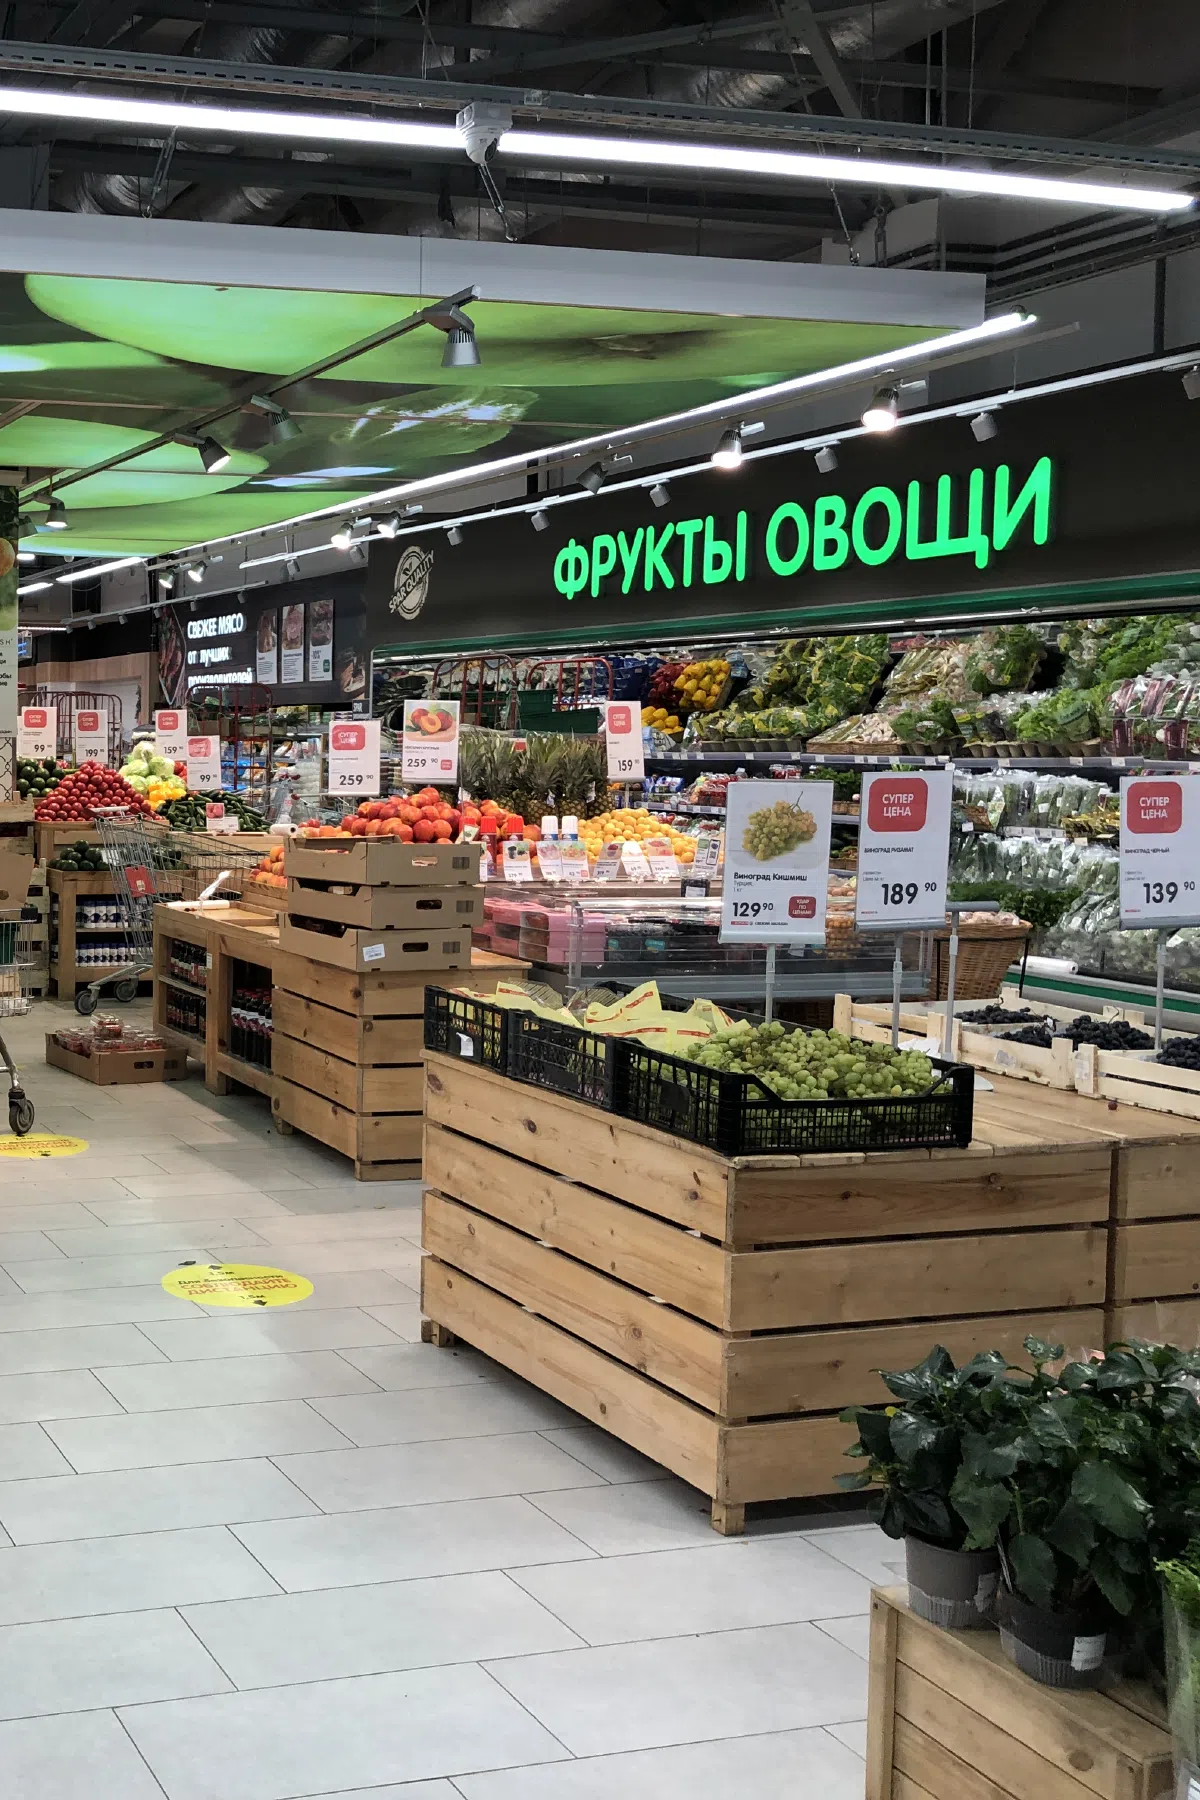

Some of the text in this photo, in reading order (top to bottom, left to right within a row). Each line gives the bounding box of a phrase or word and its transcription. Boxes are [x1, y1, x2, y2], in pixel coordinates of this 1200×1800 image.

[554, 456, 1052, 600] ФРУКТЫ ОВОЩИ
[388, 550, 434, 613] SPAR QUALITY
[187, 612, 245, 639] СВЕЖЕЕ МЯСО
[187, 646, 231, 667] от лучших
[339, 731, 358, 739] СУПЕР
[34, 744, 45, 752] 99
[85, 748, 99, 757] 199
[164, 746, 178, 754] 159
[407, 758, 427, 768] 259
[617, 759, 633, 772] 159
[200, 774, 211, 783] 99
[339, 774, 364, 786] 259
[882, 794, 914, 804] СУПЕР
[1139, 796, 1170, 807] СУПЕР
[883, 806, 912, 818] ЦЕНА
[1140, 809, 1169, 820] ЦЕНА
[733, 872, 808, 881] Виноград Кишмиш
[881, 881, 937, 906] 189 90
[1143, 881, 1196, 904] 139 90
[732, 902, 774, 918] 129 90
[181, 1277, 292, 1290] СОБЛЮДАЙТЕ
[188, 1283, 298, 1296] ДИСТАНЦИЮ
